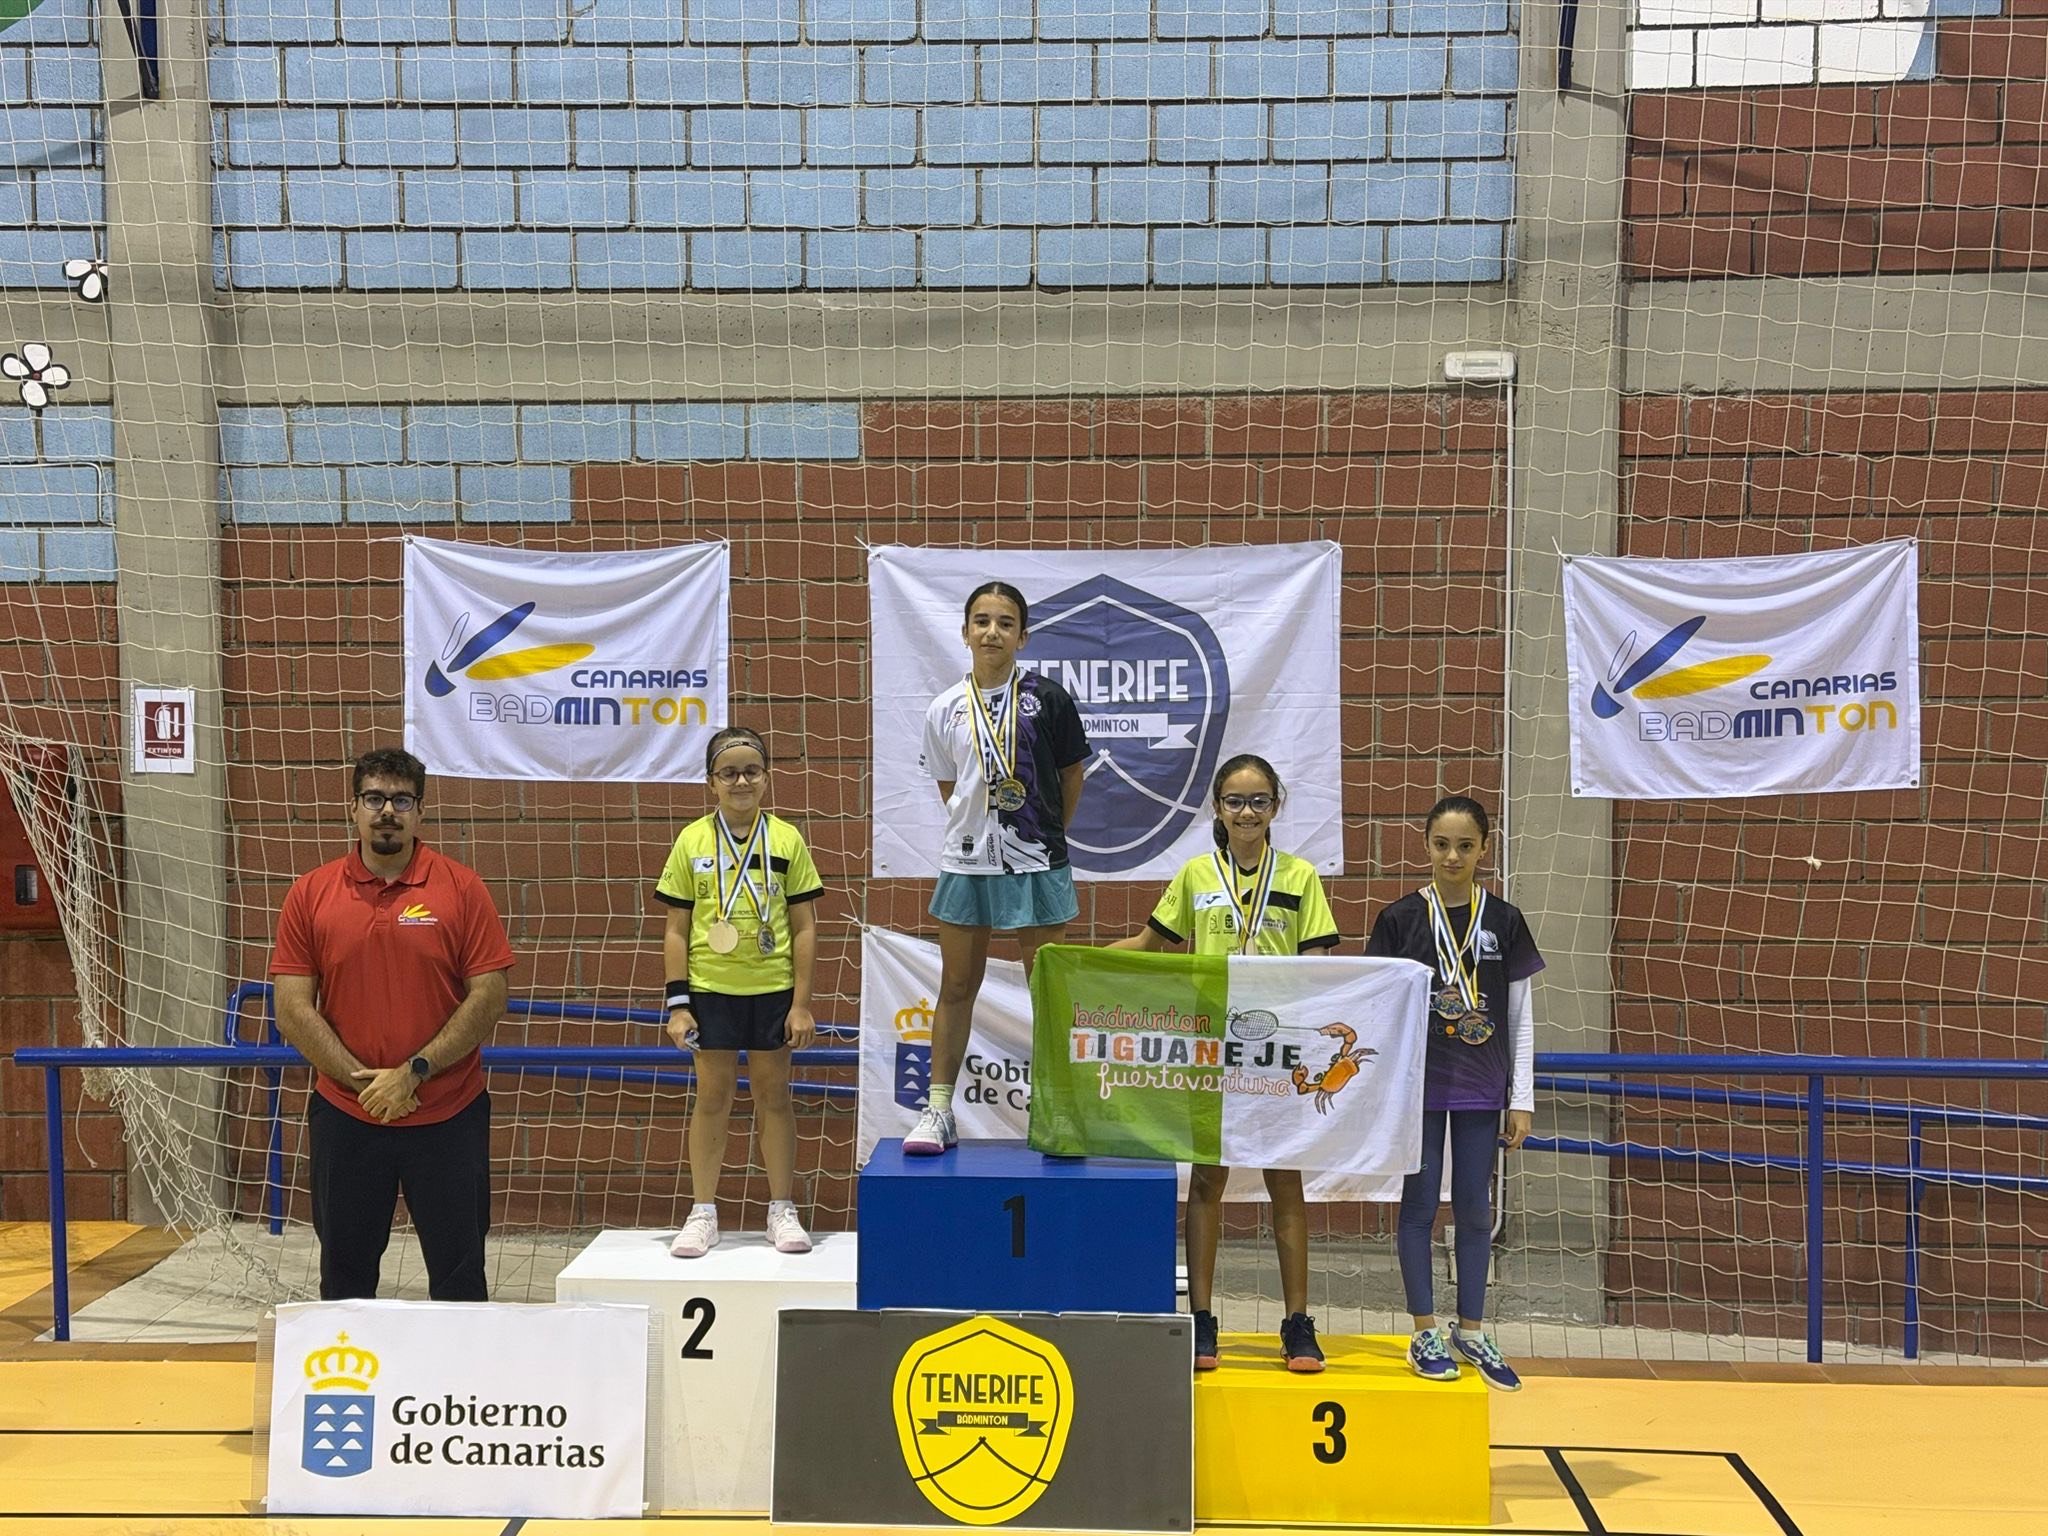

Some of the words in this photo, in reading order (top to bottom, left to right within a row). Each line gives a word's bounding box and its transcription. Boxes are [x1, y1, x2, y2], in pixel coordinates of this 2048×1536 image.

[571, 669, 708, 689] CANARIAS
[1750, 671, 1897, 700] CANARIAS
[469, 692, 708, 726] BADMINTON
[1084, 719, 1139, 732] DMINTON
[1639, 700, 1897, 742] BADMINTON
[1073, 1003, 1211, 1034] bádminton
[1073, 1033, 1302, 1070] TIGUANEJE
[965, 1054, 1031, 1085] Gobi
[1097, 1062, 1291, 1100] fuerteventura
[964, 1079, 999, 1105] de
[1003, 1195, 1026, 1258] 1
[681, 1297, 717, 1360] 2
[921, 1373, 1044, 1405] TENERIFE
[392, 1394, 568, 1428] Gobierno
[1312, 1401, 1347, 1465] 3
[390, 1433, 434, 1465] de
[442, 1435, 605, 1468] Canarias
